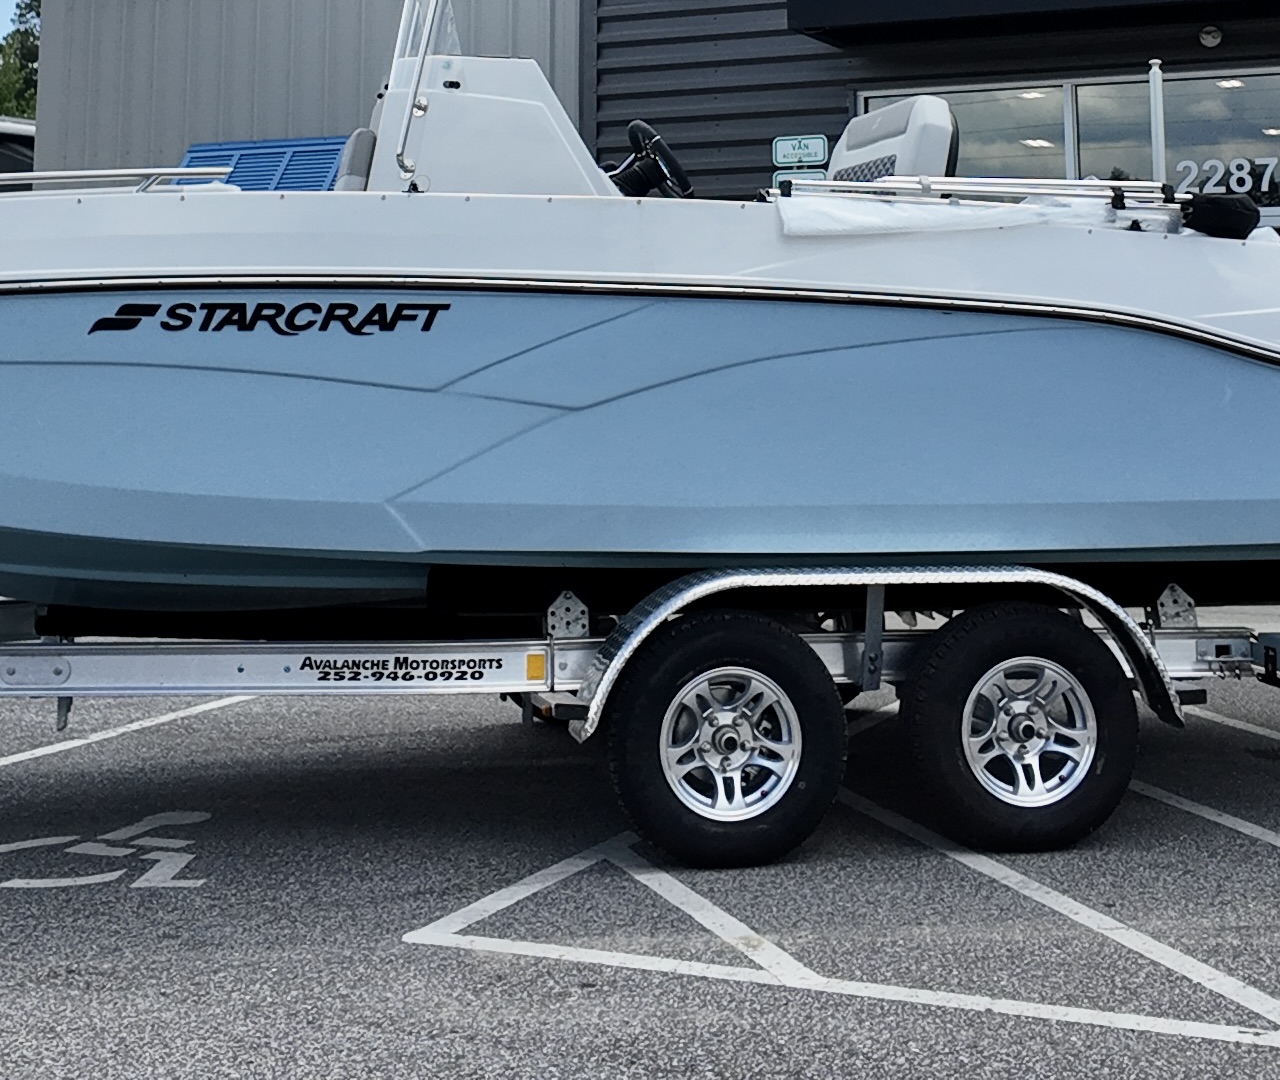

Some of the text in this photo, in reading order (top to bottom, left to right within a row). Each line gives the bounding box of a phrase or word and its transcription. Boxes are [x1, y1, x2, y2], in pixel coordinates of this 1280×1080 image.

[791, 141, 809, 151] VAN
[1176, 157, 1278, 193] 2287
[160, 303, 451, 336] STARCRAFT
[317, 671, 484, 682] 252-946-0920
